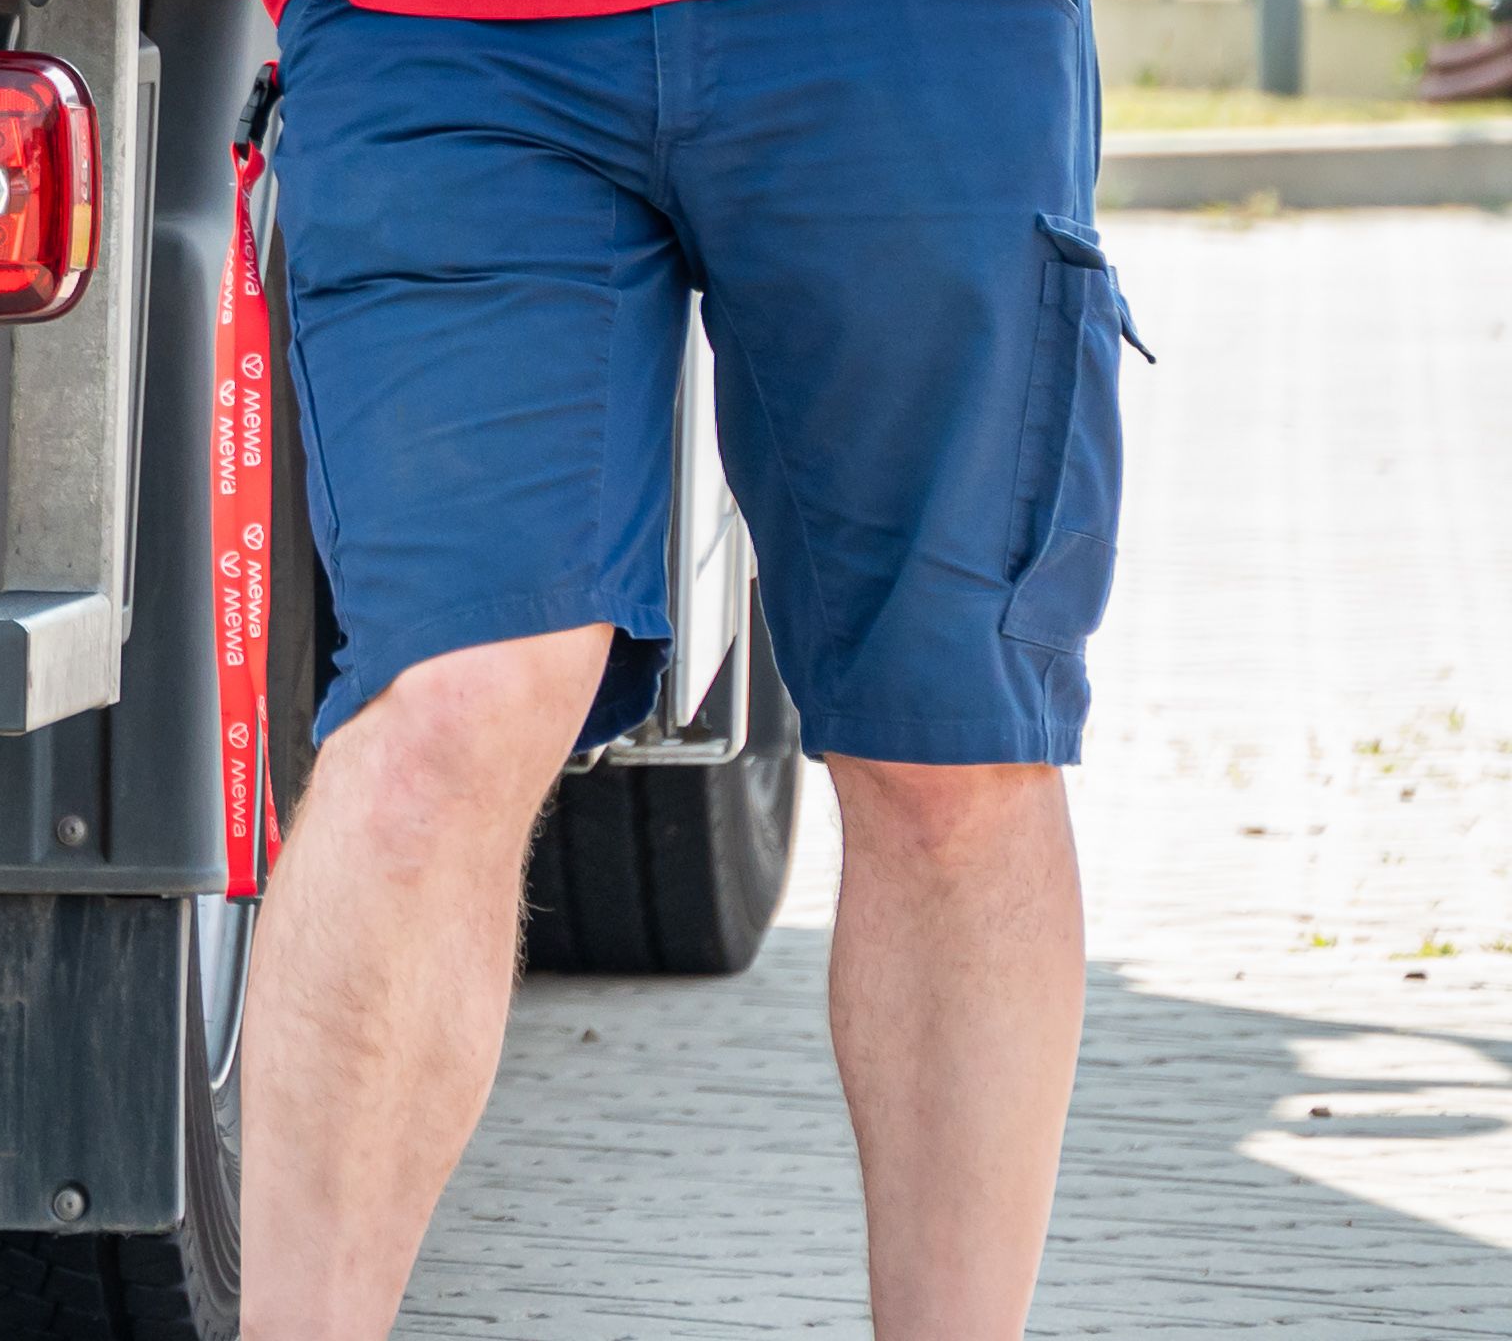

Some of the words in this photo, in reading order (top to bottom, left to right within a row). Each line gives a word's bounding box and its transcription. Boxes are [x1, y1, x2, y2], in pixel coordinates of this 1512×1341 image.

[218, 417, 237, 496] mewa
[242, 388, 262, 468] mewa
[223, 587, 245, 667] mewa
[246, 559, 264, 639] mewa
[230, 758, 247, 838] mewa
